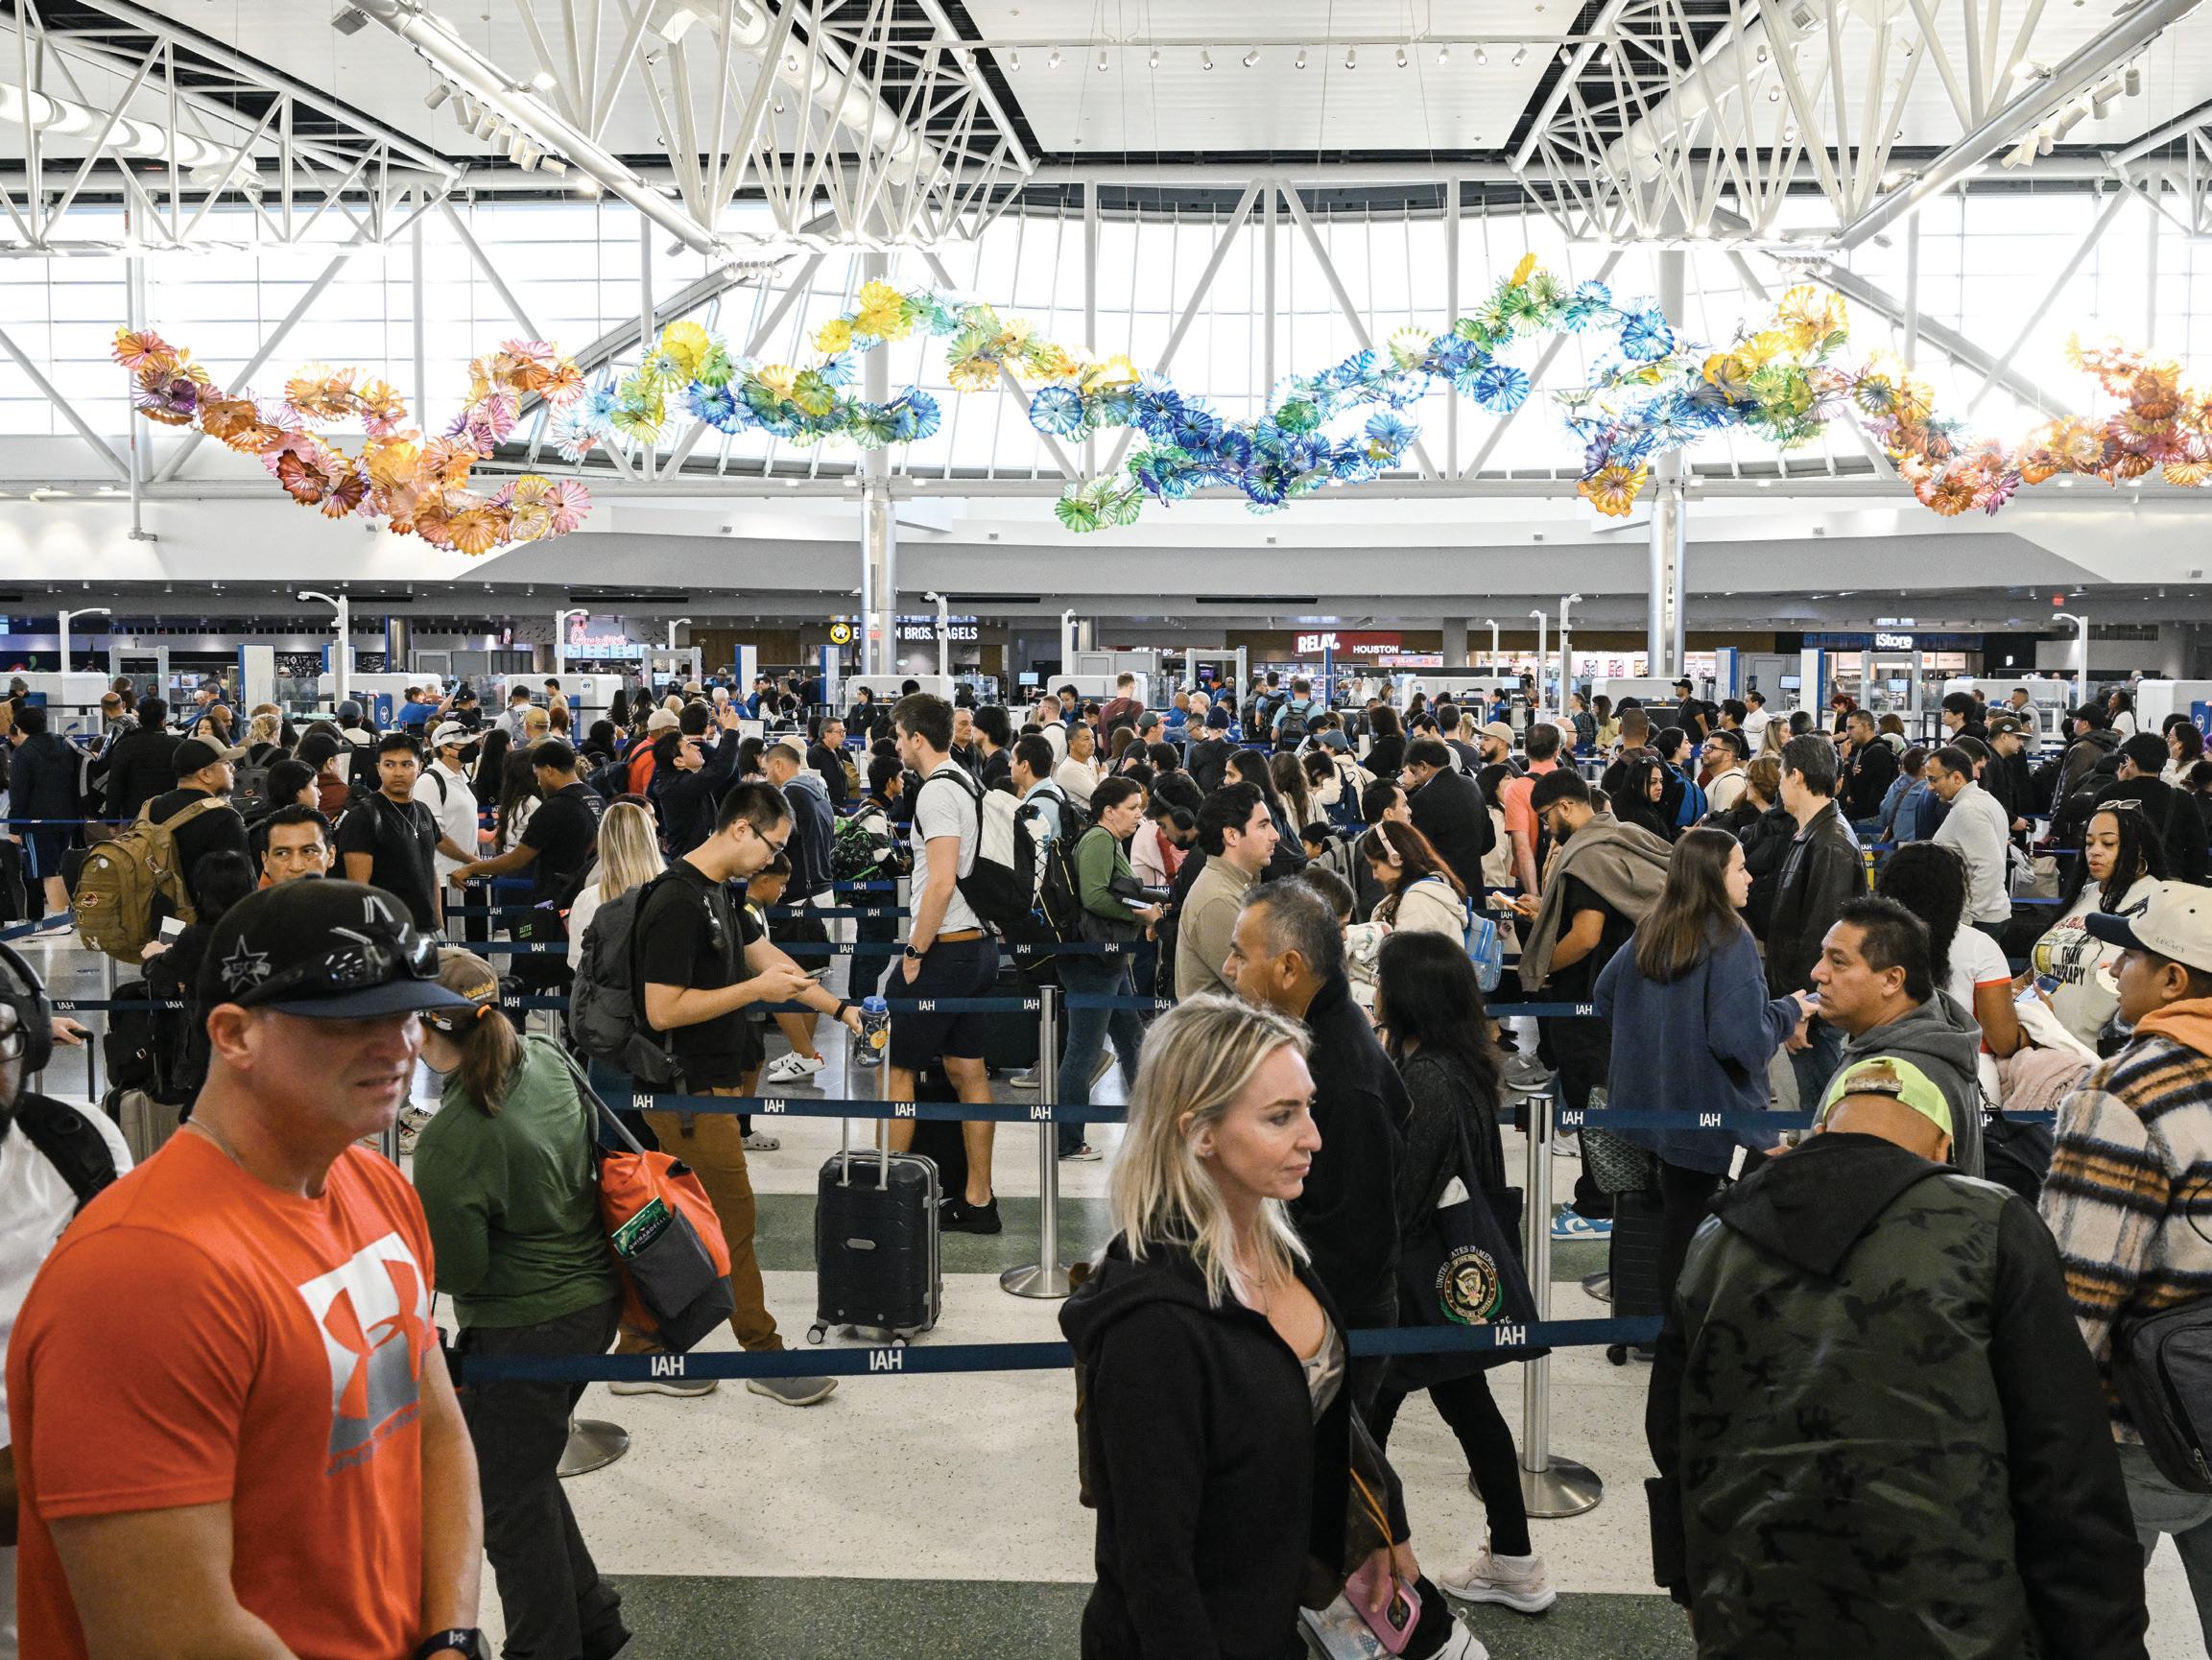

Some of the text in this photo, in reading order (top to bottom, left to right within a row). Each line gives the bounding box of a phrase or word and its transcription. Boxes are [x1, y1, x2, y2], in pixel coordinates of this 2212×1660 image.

[905, 627, 934, 640] BROS.
[1298, 633, 1399, 654] RELAY HOUSTON
[1875, 633, 1913, 647] iStore
[1162, 648, 1174, 656] go
[853, 882, 867, 890] IAH
[489, 907, 502, 915] IAH
[791, 908, 804, 917] IAH
[868, 908, 880, 916] IAH
[1500, 911, 1513, 919] IAH
[531, 942, 546, 952] IAH
[840, 944, 854, 954] IAH
[1016, 944, 1032, 954] IAH
[1105, 942, 1119, 952] IAH
[57, 1001, 76, 1011] IAH
[165, 1000, 184, 1009] IAH
[504, 996, 521, 1008] IAH
[918, 1000, 936, 1011] IAH
[1023, 999, 1040, 1010] IAH
[1154, 999, 1172, 1010] IAH
[1575, 1004, 1593, 1015] IAH
[632, 1094, 654, 1109] IAH
[764, 1099, 785, 1113] IAH
[894, 1103, 916, 1117] IAH
[1030, 1105, 1053, 1121] IAH
[1561, 1111, 1584, 1126] IAH
[1700, 1113, 1722, 1127] IAH
[628, 1217, 666, 1250] GHIRARDELLI
[1436, 1261, 1450, 1289] UNITED
[1495, 1325, 1527, 1346] IAH
[868, 1349, 903, 1371] IAH
[651, 1355, 685, 1377] IAH
